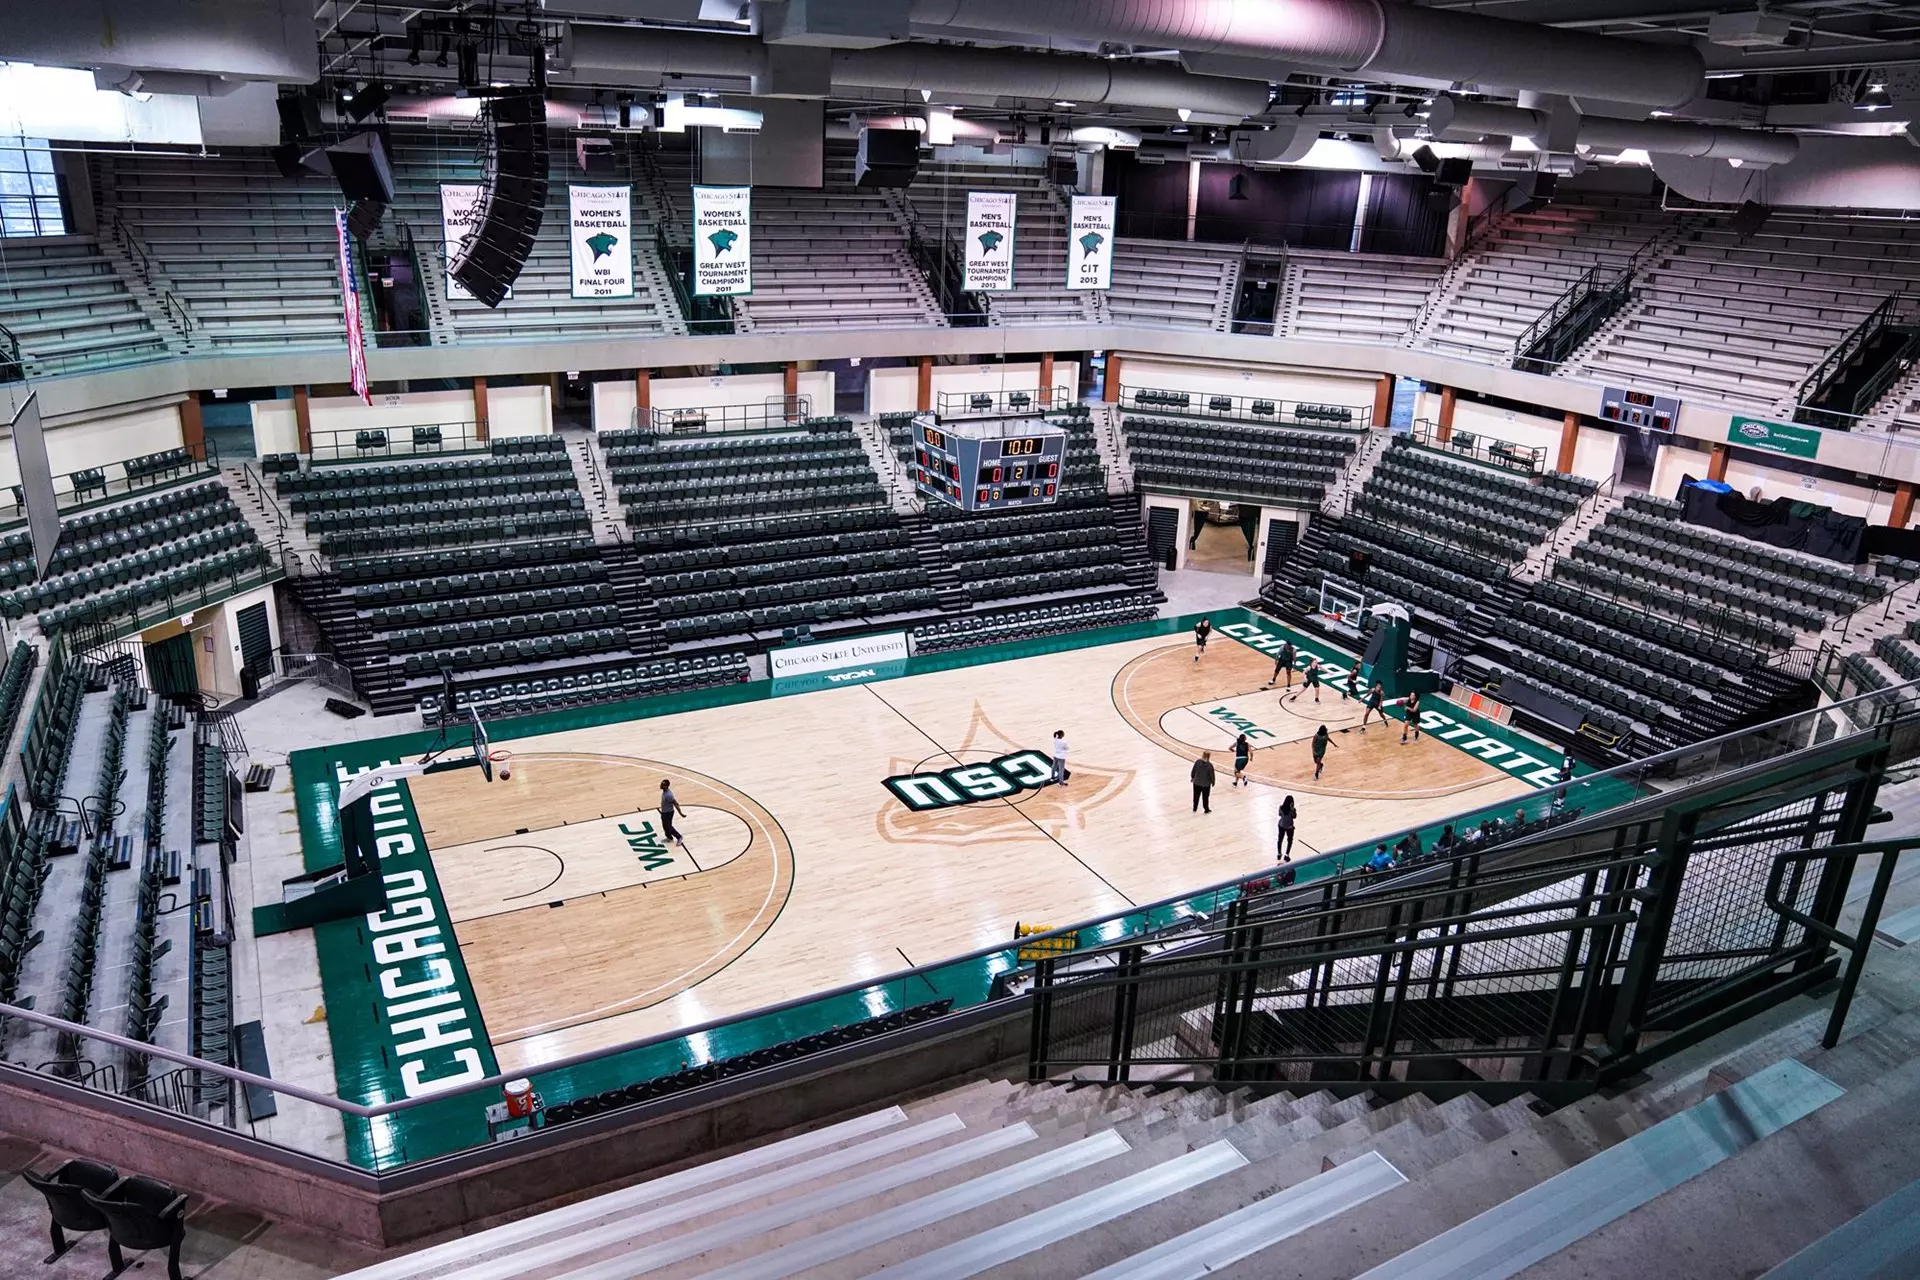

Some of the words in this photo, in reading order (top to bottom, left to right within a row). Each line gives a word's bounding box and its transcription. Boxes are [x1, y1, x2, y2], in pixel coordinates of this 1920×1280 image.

[571, 190, 606, 199] CHICAGO
[695, 192, 728, 200] CHICAGO
[580, 210, 621, 218] WOMEN'S
[703, 210, 742, 218] WOMEN'S
[981, 213, 1002, 221] MEN'S
[574, 220, 627, 228] BASKETBALL
[698, 219, 747, 227] BASKETBALL
[969, 220, 1012, 229] BASKETBALL
[1073, 222, 1111, 230] BASKETBALL
[725, 261, 746, 269] WEST
[1081, 264, 1099, 273] CIT
[698, 269, 748, 278] TOURNAMENT
[967, 267, 1010, 275] TOURNAMENT
[701, 277, 745, 285] CHAMPIONS
[1080, 276, 1098, 285] 2013
[1008, 440, 1034, 455] 10.0
[1038, 455, 1058, 463] GUEST
[934, 459, 939, 470] 2
[1015, 467, 1023, 479] 2
[1048, 463, 1058, 477] 0
[992, 468, 1002, 482] 0
[1033, 487, 1039, 496] 0
[1046, 484, 1054, 496] 0
[980, 490, 988, 502] 0
[993, 491, 999, 500] 0
[775, 655, 819, 669] CHICAGO
[821, 651, 849, 662] STATE
[851, 642, 905, 657] UNIVERSITY
[828, 668, 876, 682] NCAA
[1209, 706, 1277, 740] WAC
[1418, 710, 1578, 790] STATE
[893, 752, 1062, 808] CSU
[618, 821, 675, 871] WAC
[366, 869, 485, 1098] CHICAGO
